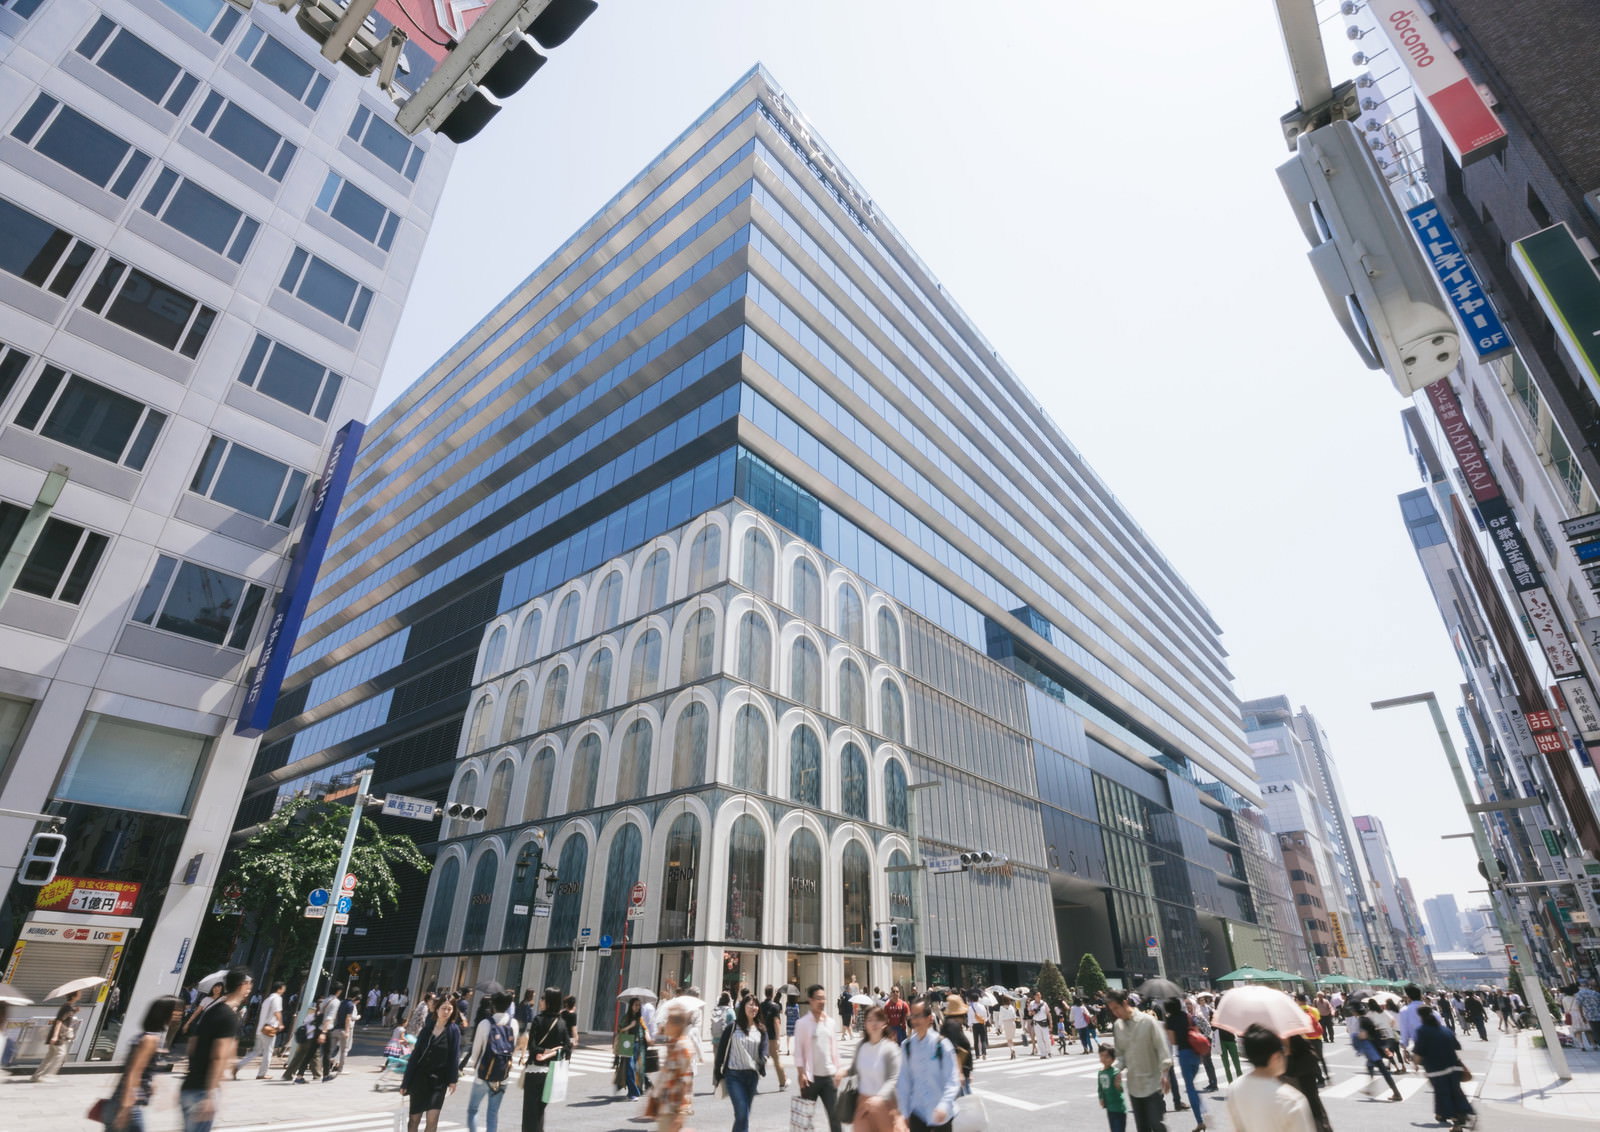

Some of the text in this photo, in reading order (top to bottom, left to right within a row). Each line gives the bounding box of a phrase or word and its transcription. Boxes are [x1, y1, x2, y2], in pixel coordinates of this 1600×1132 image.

[1389, 10, 1435, 68] docomo
[1412, 207, 1488, 329] アートネイチャー
[1479, 332, 1503, 349] 6F
[1447, 422, 1492, 490] NATARAJ
[315, 443, 344, 512] MIZUHO
[1490, 515, 1508, 528] 6F
[1537, 734, 1556, 743] UNI
[1541, 741, 1561, 751] QLO
[81, 896, 116, 911] 1億円
